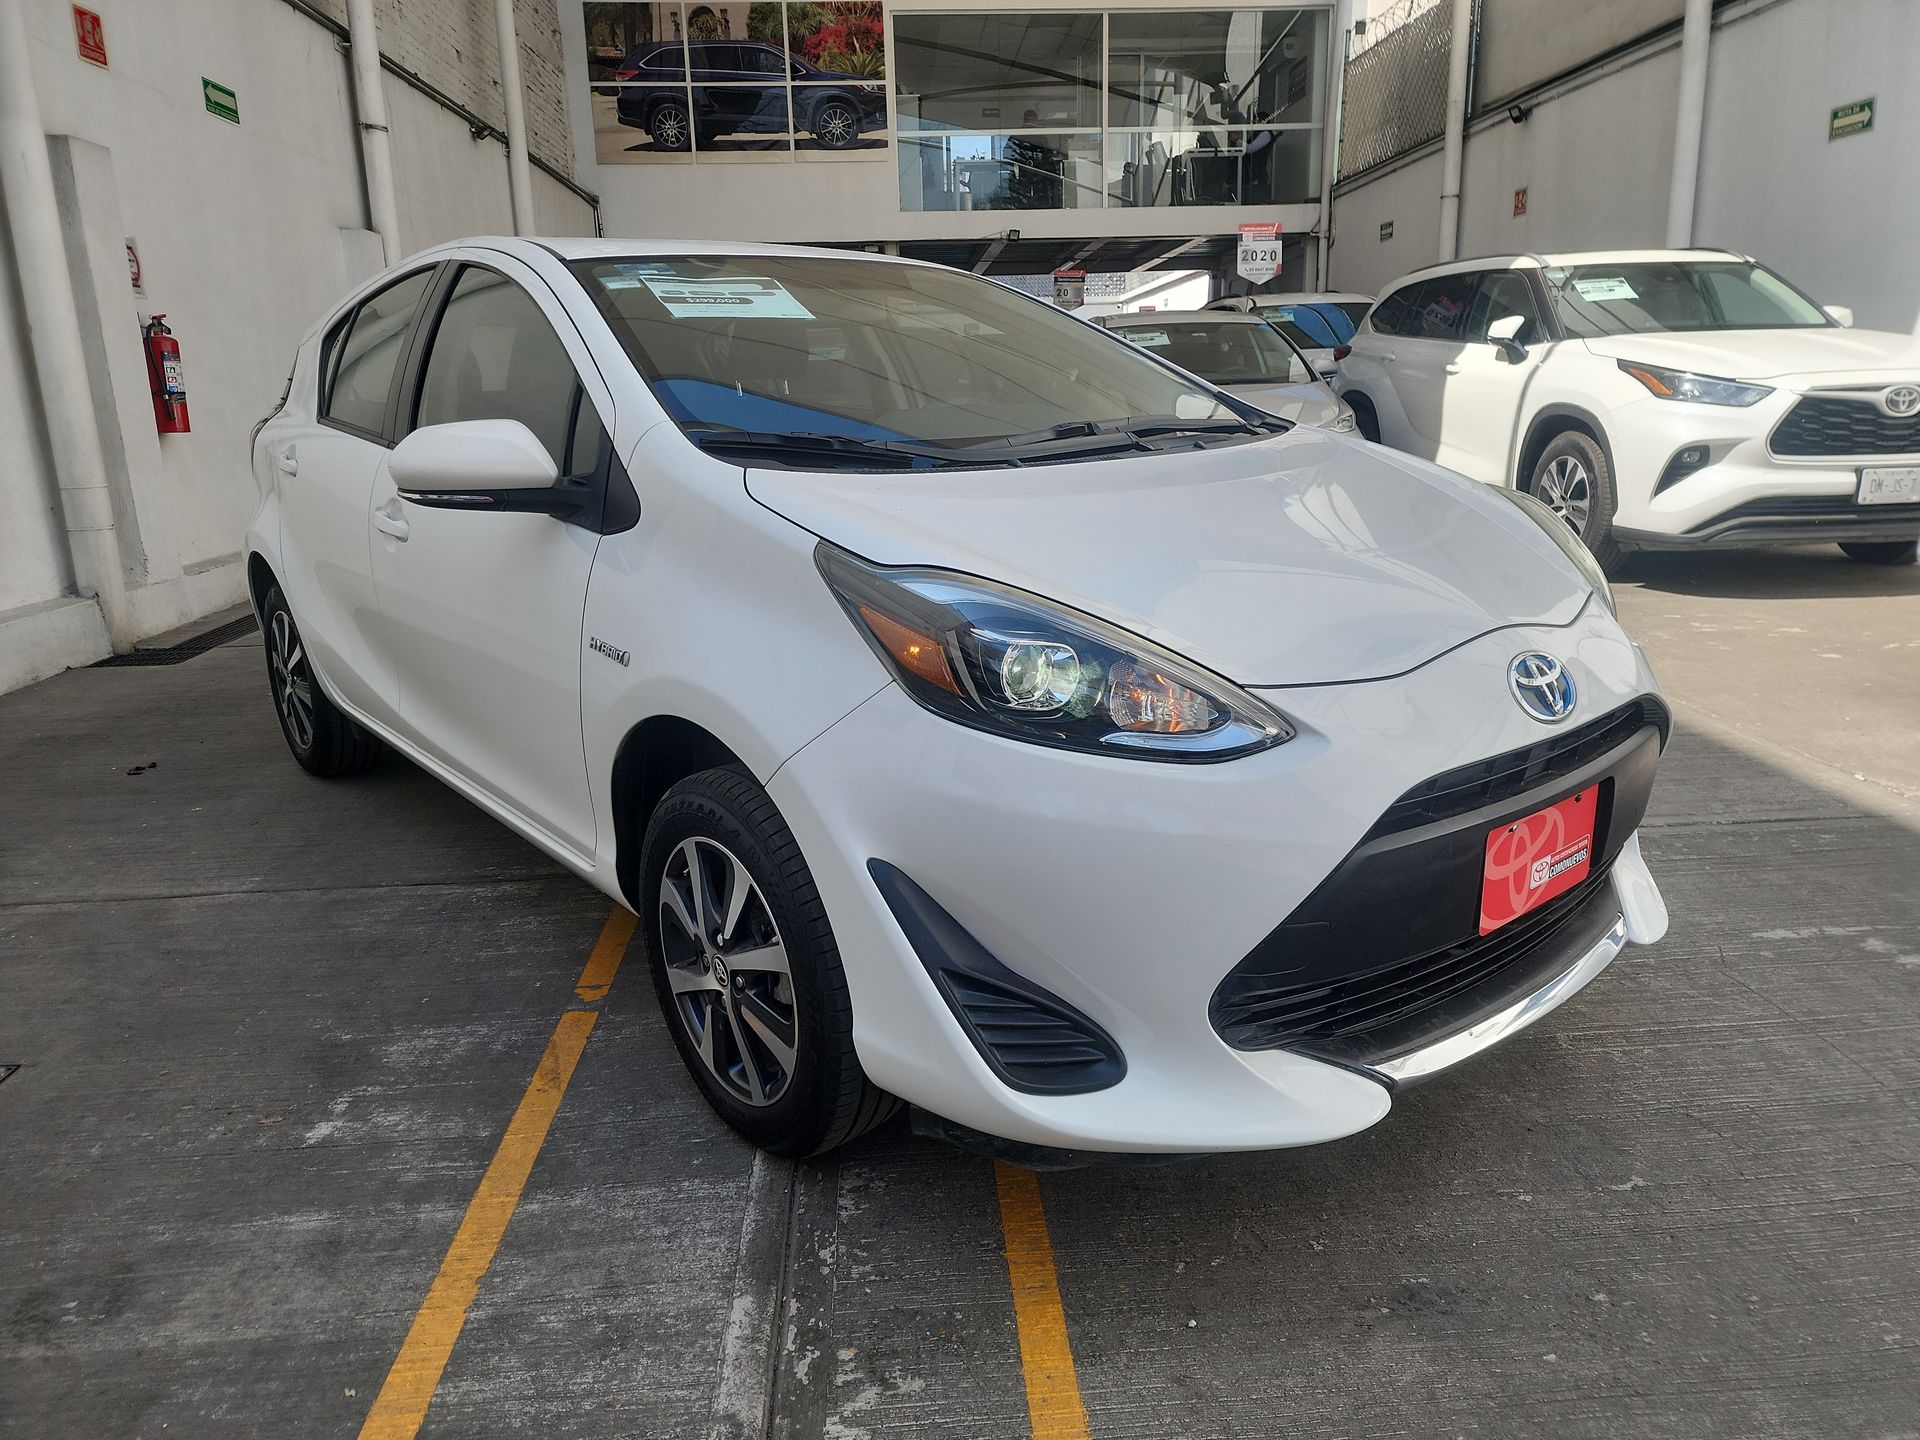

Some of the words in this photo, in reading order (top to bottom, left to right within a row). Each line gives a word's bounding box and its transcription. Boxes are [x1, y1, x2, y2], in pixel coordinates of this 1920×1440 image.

[1241, 250, 1277, 261] 2020
[590, 636, 622, 664] HYBRID
[1550, 847, 1588, 878] COMONUEVOS
